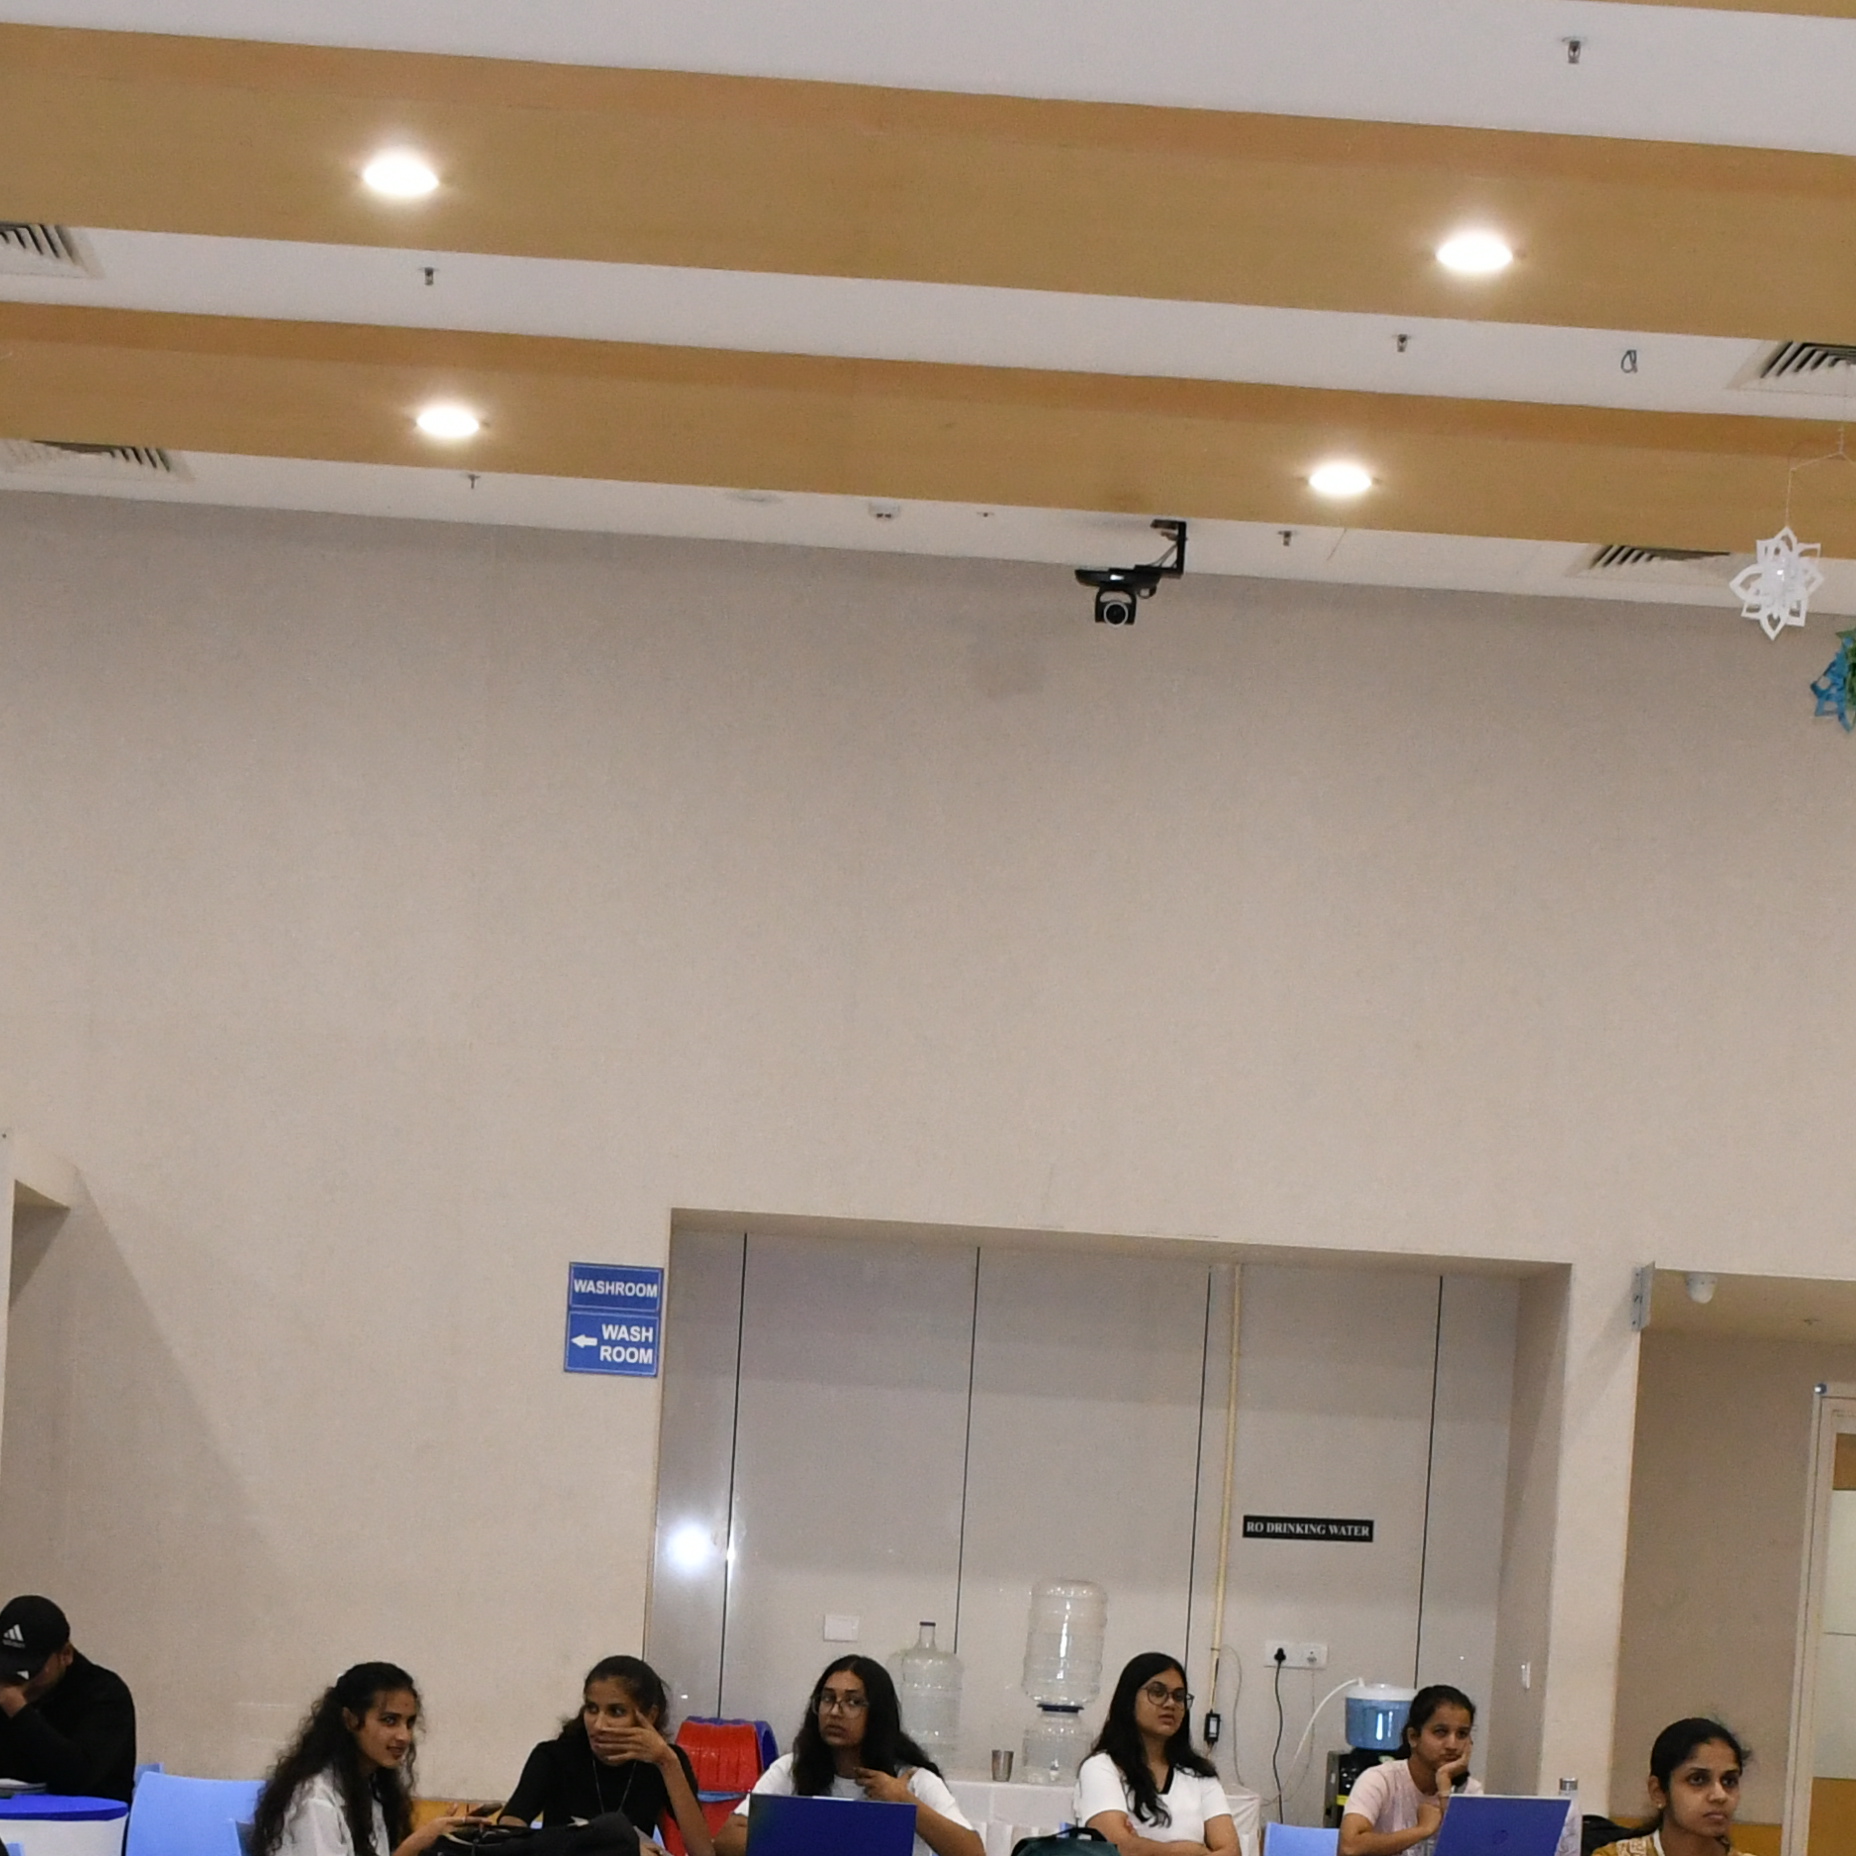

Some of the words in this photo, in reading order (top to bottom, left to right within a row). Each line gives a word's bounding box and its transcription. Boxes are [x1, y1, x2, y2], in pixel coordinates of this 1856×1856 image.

[573, 1279, 658, 1298] WASHROOM
[601, 1323, 654, 1343] WASH
[599, 1345, 653, 1364] ROOM
[1246, 1521, 1264, 1532] RO
[1266, 1522, 1326, 1535] DRINKING
[1328, 1524, 1370, 1537] WATER
